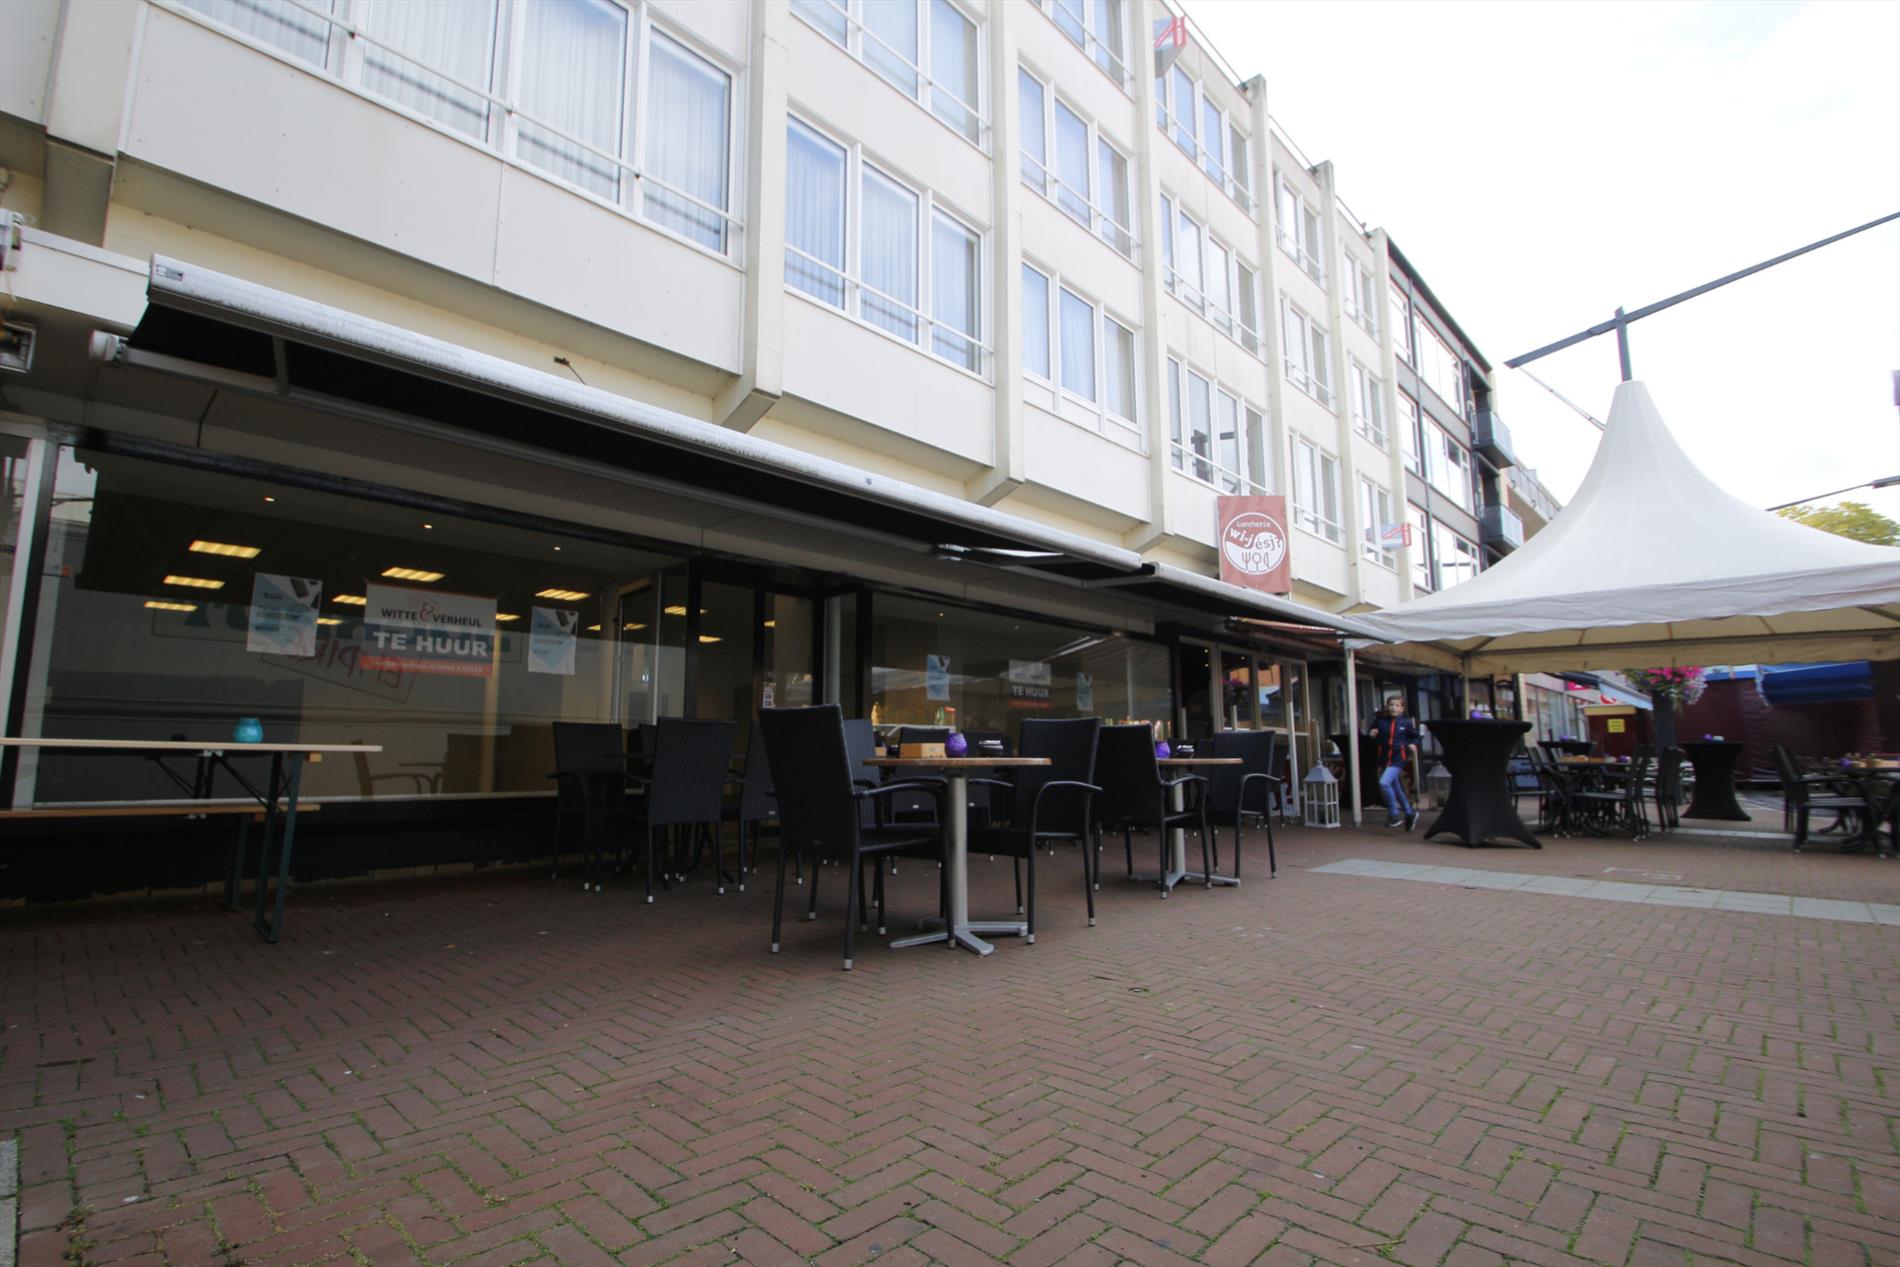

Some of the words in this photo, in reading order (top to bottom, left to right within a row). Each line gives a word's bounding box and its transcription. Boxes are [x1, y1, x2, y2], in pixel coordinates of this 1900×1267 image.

[381, 608, 418, 622] WITTE
[433, 614, 482, 628] VERHEUL
[373, 631, 407, 650] TE
[416, 636, 488, 657] HUUR
[1012, 686, 1024, 696] TE
[1025, 687, 1050, 699] HUUR
